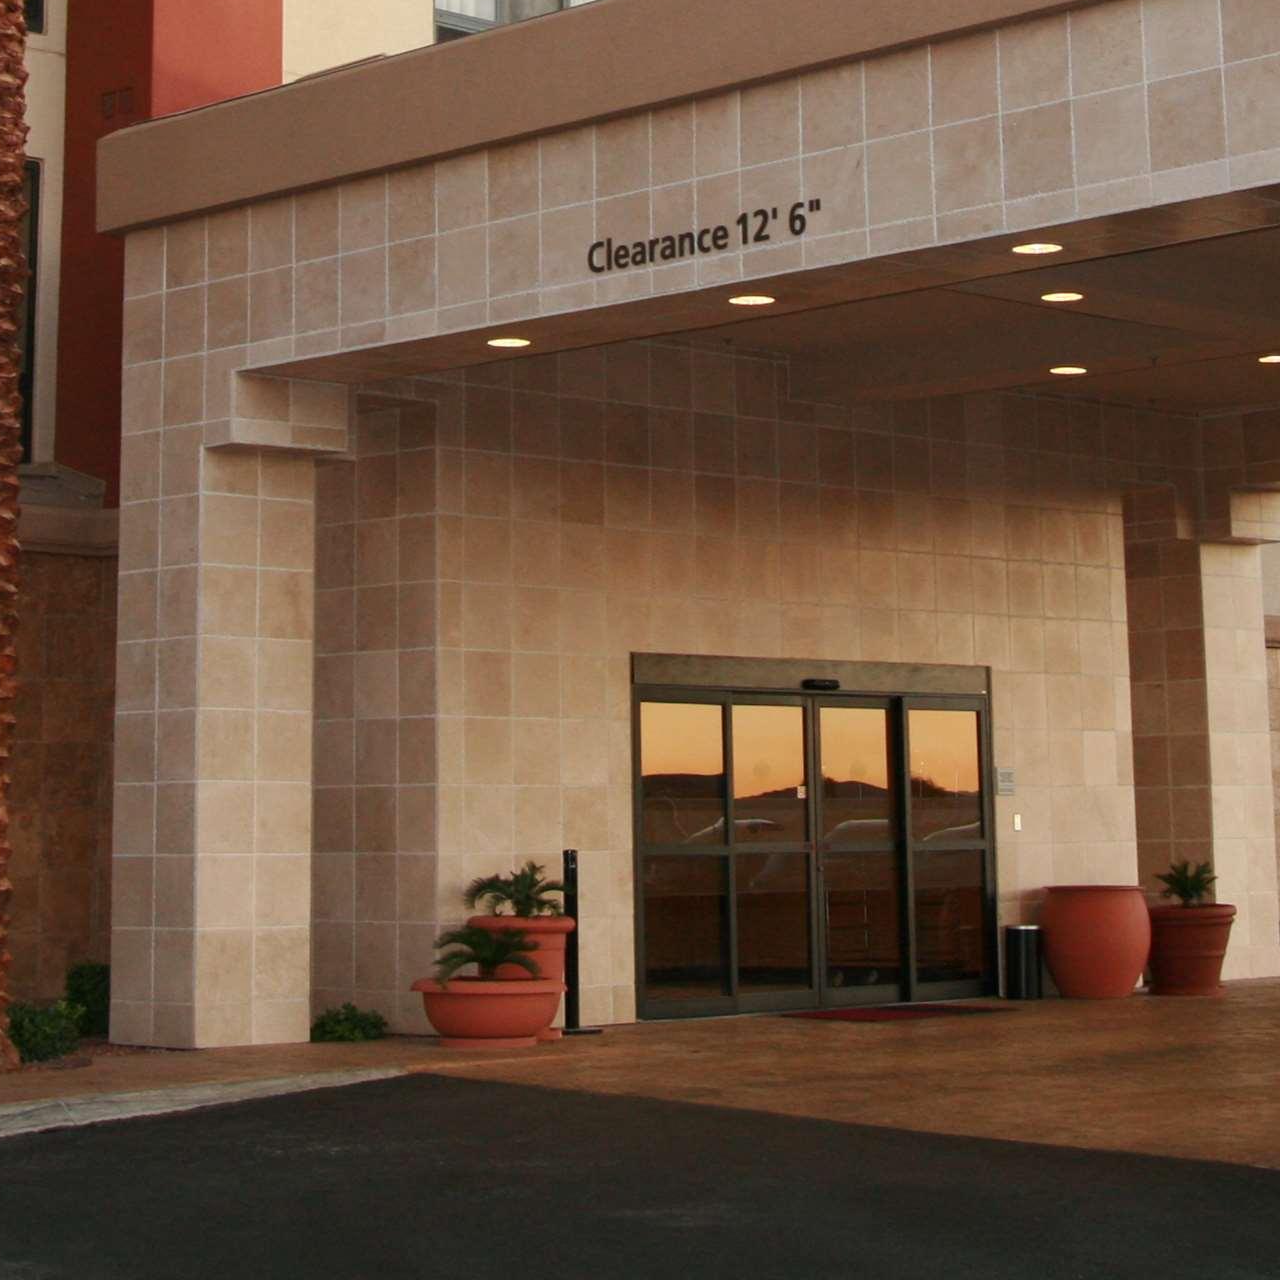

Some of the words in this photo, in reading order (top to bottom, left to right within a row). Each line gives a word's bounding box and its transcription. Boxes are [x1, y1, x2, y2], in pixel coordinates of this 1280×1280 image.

[587, 224, 729, 274] Clearance
[735, 206, 778, 246] 12'
[788, 197, 821, 237] 6"
